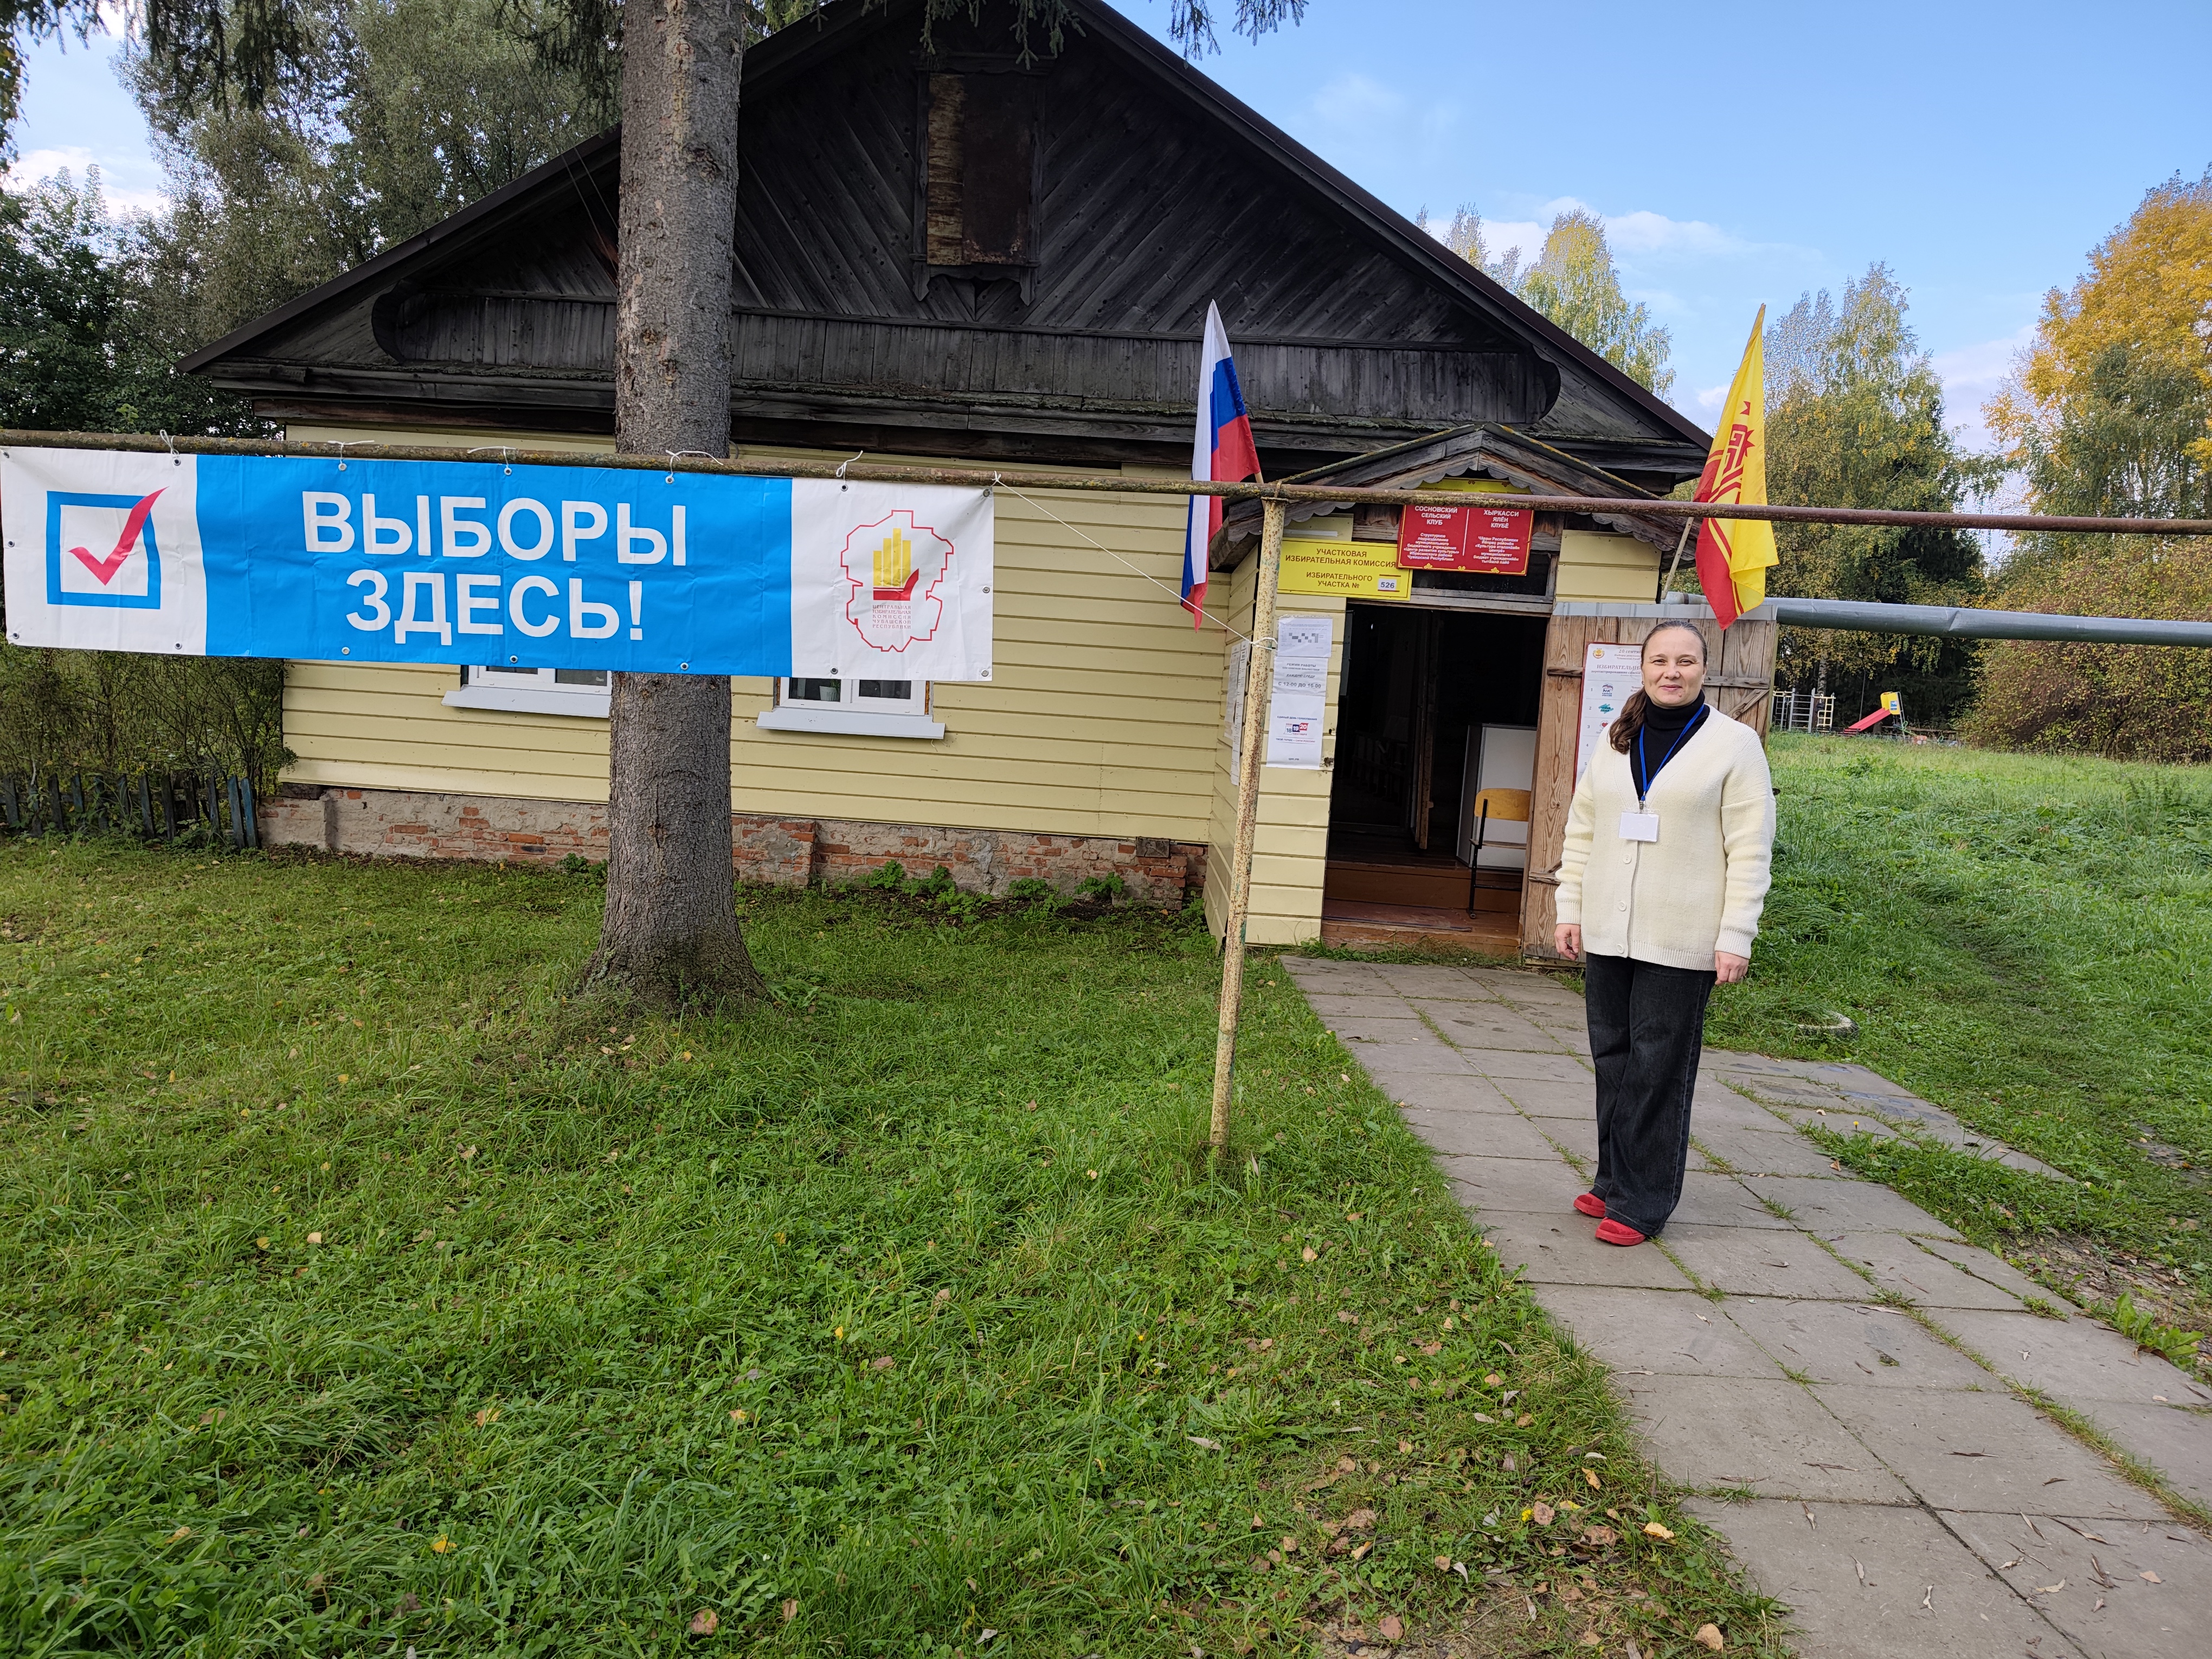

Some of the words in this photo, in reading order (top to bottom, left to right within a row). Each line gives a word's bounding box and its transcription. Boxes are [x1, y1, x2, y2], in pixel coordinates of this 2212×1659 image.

[1414, 505, 1457, 513] СОСНОВСКИЙ
[302, 491, 686, 566] ВЫБОРЫ
[1316, 548, 1367, 557] УЧАСТКОВАЯ
[1285, 555, 1351, 565] ИЗБИРАТЕЛЬНАЯ
[1353, 560, 1396, 568] КОМИССИЯ
[1306, 572, 1372, 581] ИЗБИРАТЕЛЬНОГО
[1317, 580, 1349, 588] УЧАСТКА
[345, 569, 642, 646] ЗДЕСЬ!
